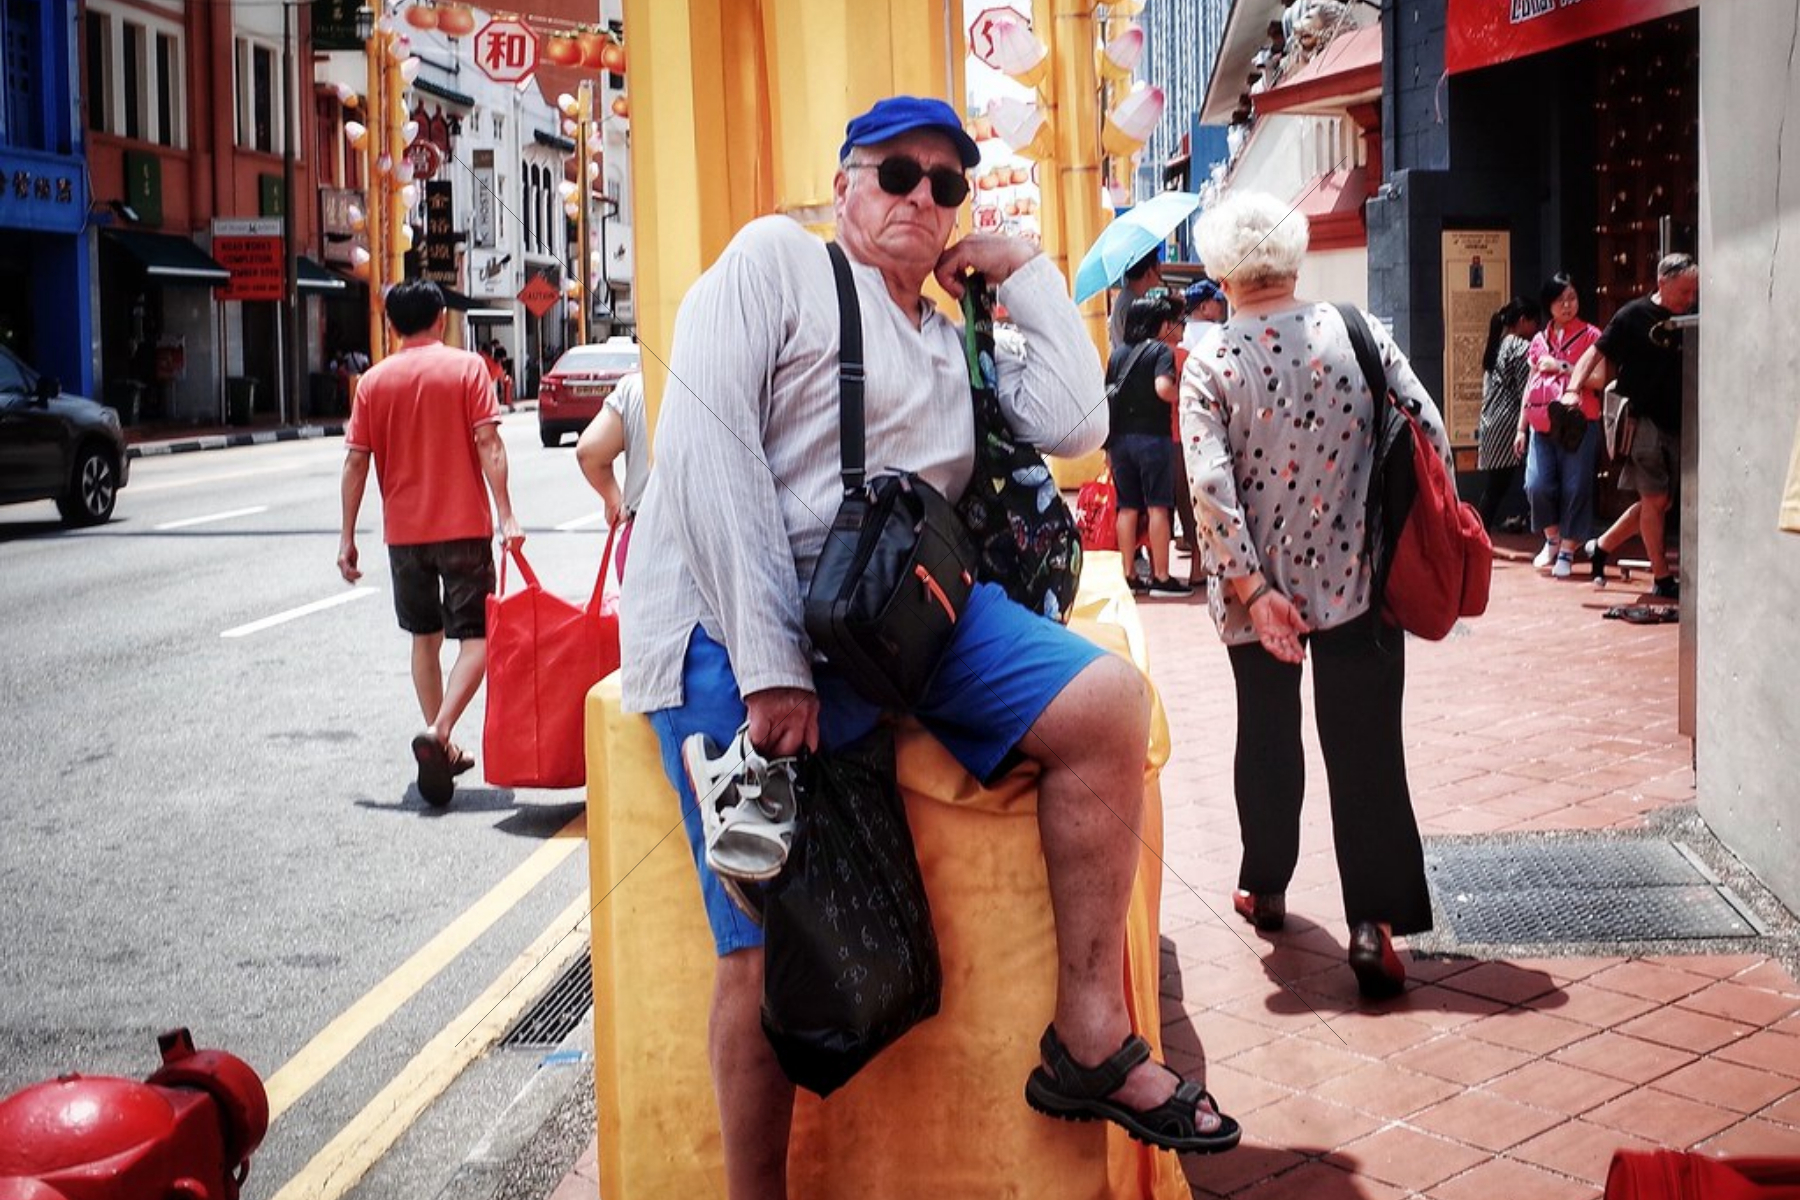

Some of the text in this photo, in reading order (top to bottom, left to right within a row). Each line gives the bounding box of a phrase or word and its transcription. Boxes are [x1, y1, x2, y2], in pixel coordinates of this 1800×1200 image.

[486, 31, 526, 69] 和
[221, 242, 272, 250] ROAD WORKS
